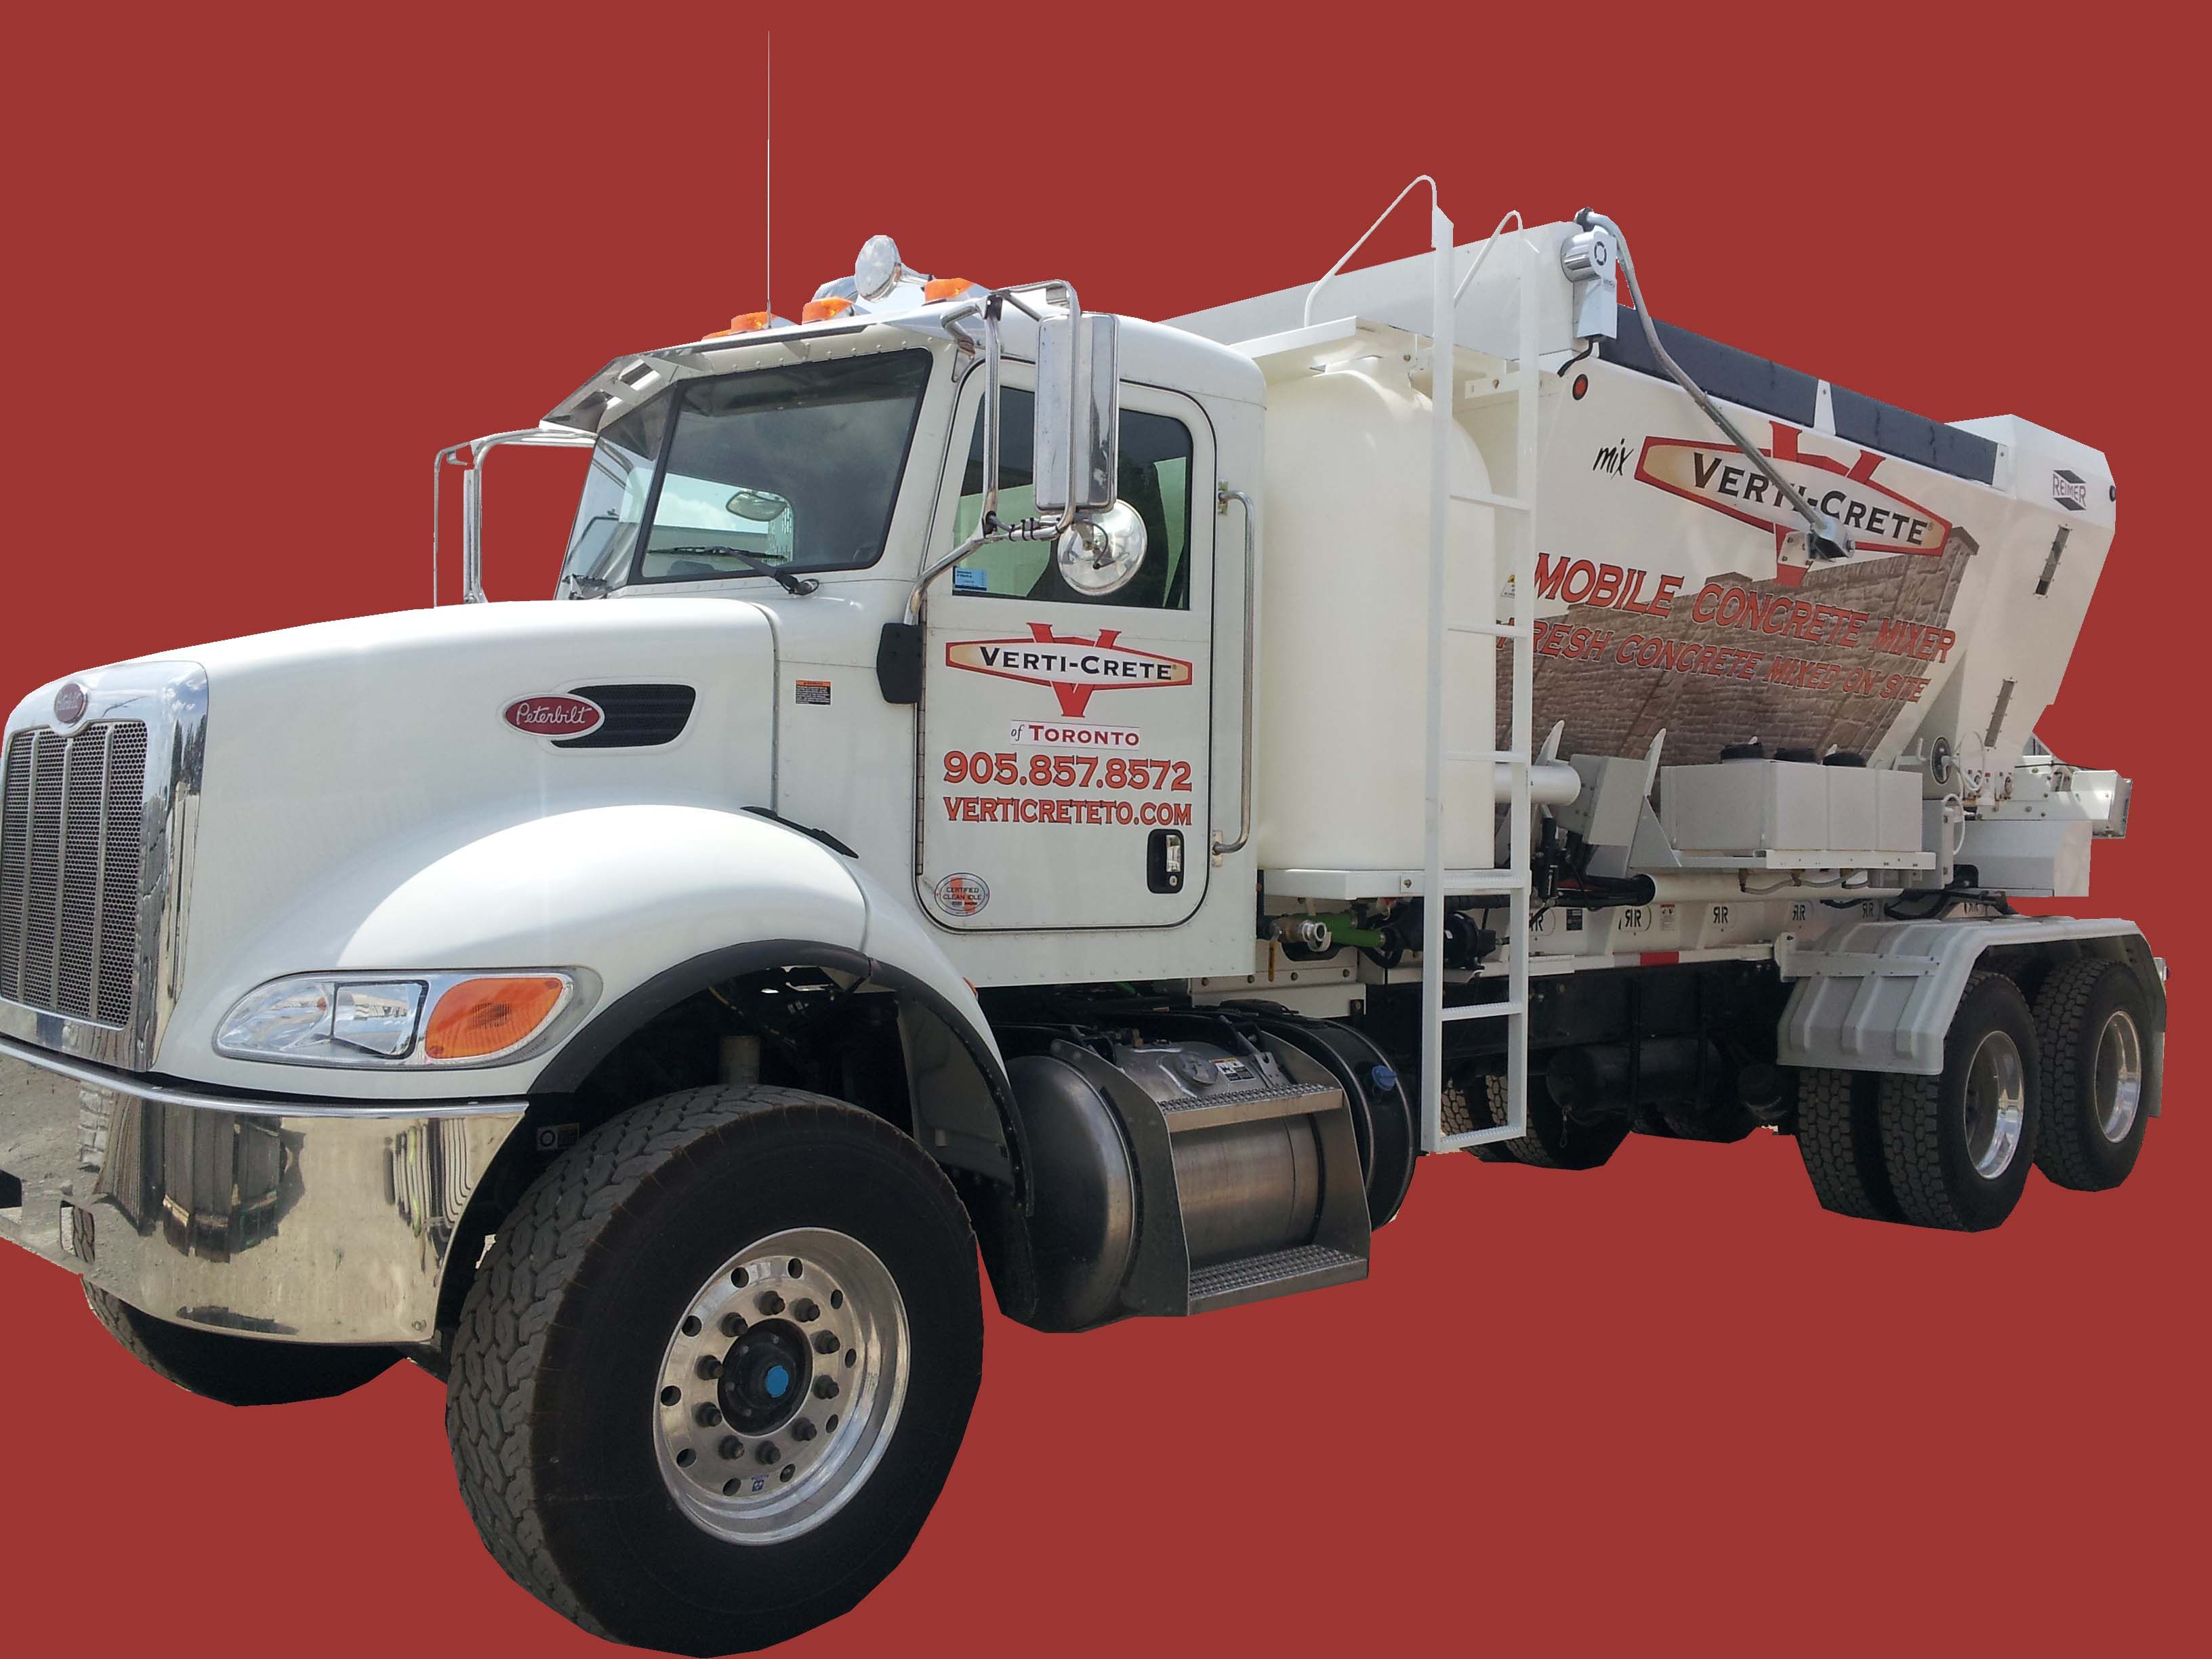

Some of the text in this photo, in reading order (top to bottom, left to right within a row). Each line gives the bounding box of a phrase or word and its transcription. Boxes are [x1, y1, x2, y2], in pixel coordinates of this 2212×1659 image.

[1593, 438, 1634, 479] mix
[2052, 473, 2087, 508] REIMER
[1534, 552, 1956, 663] MOBILE CONCRETE MIXER
[979, 646, 1172, 680] VERTI-CRETE
[1496, 617, 1931, 702] RESH CONCRETE MIXED ON SITE
[516, 702, 592, 725] Peterbilt
[1010, 724, 1139, 746] of TORONTO
[943, 750, 1192, 792] 905.857.8572
[943, 796, 1192, 826] VERTICRETETO.COM
